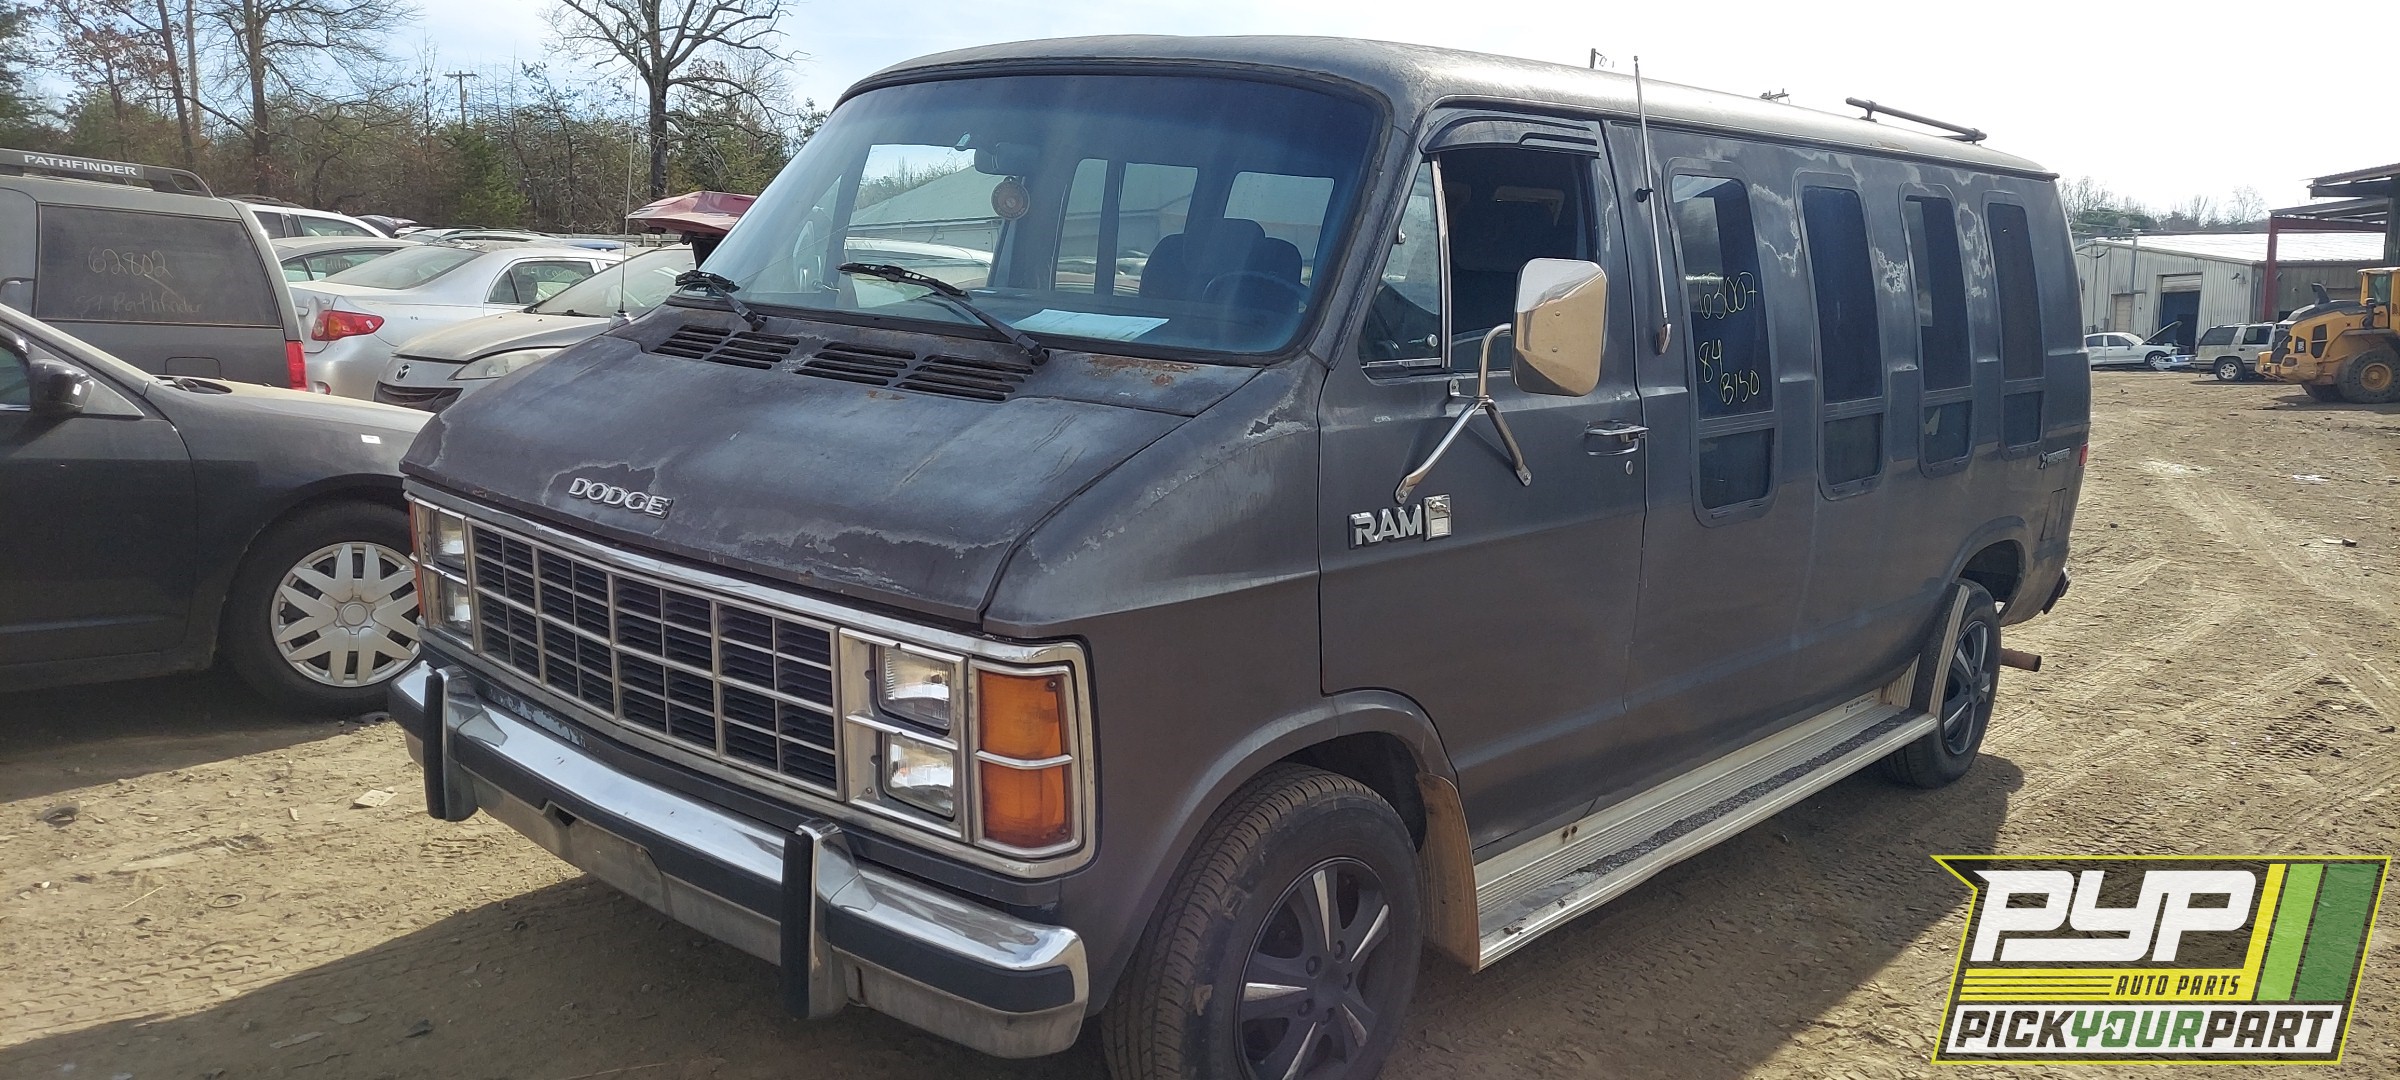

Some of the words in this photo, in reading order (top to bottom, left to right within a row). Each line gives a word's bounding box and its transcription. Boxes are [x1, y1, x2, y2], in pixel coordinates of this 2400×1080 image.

[23, 154, 137, 176] PATHFINDER
[88, 246, 175, 280] 62802
[1699, 271, 1757, 319] 63007
[1698, 339, 1723, 383] 84
[1720, 369, 1760, 405] B150
[568, 477, 674, 519] DODGE
[1348, 503, 1422, 549] RAM
